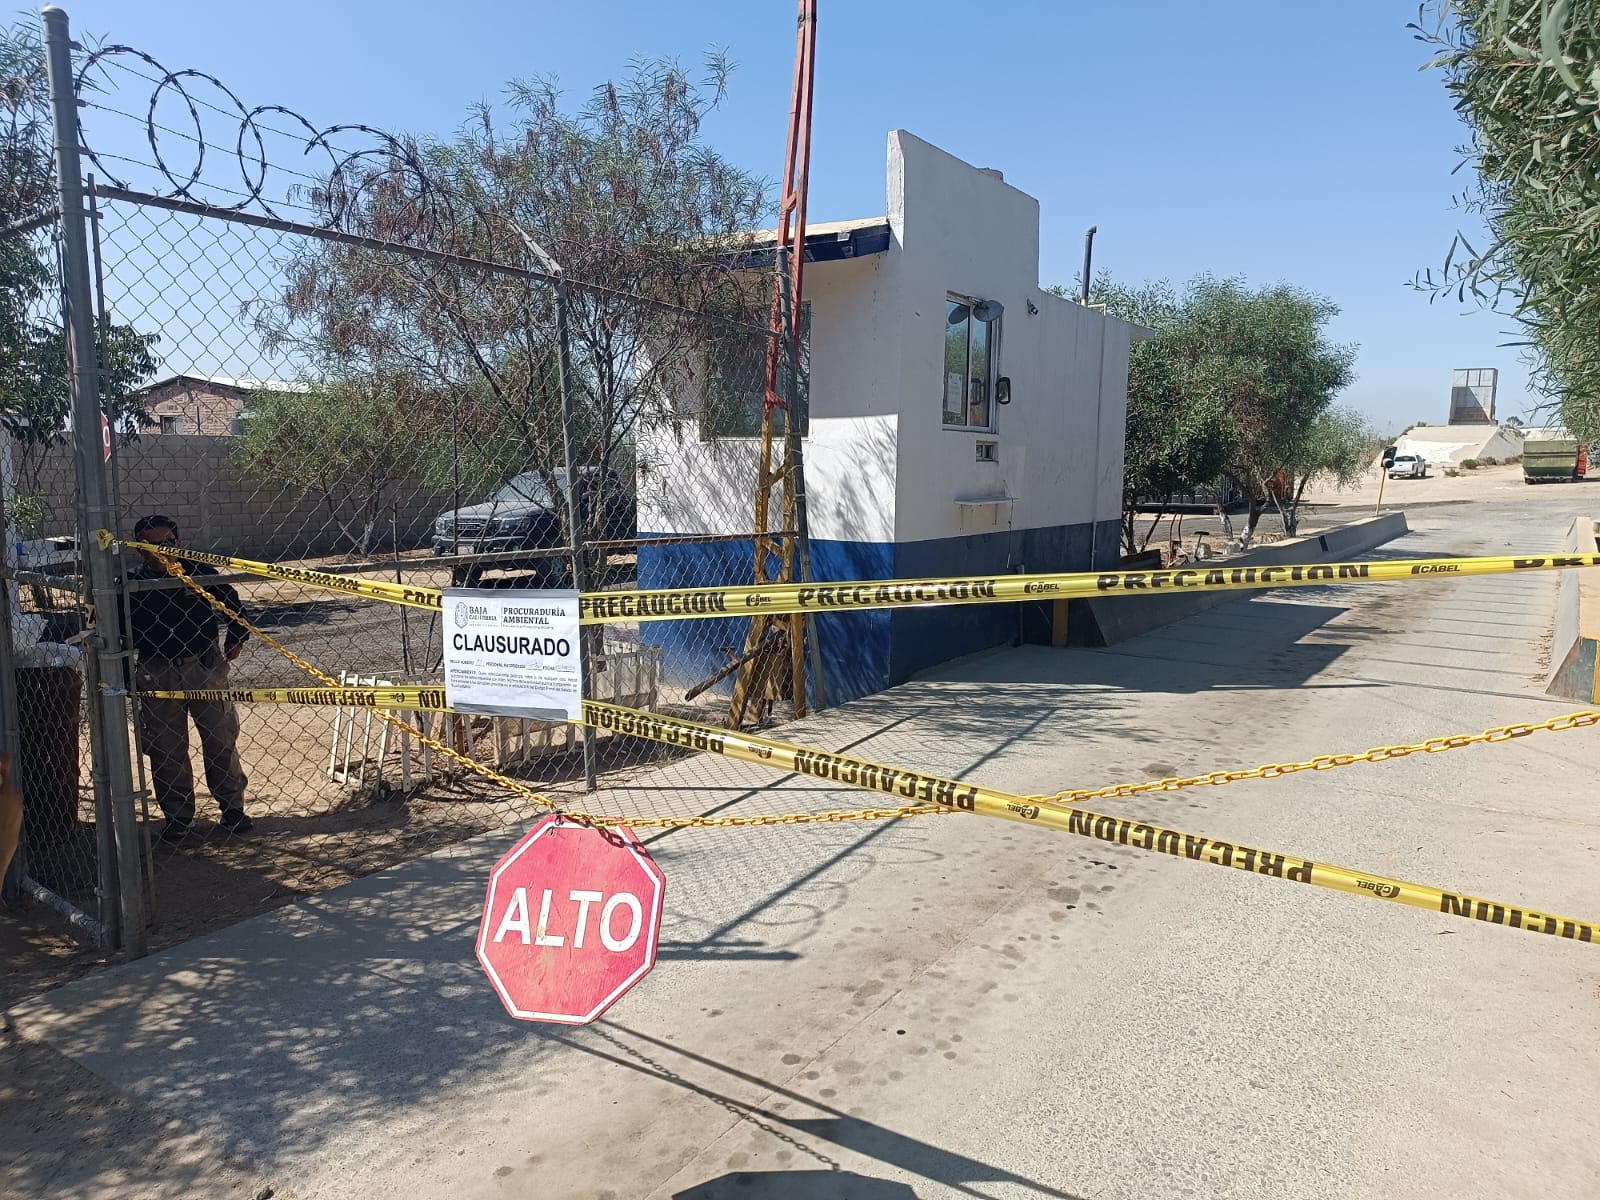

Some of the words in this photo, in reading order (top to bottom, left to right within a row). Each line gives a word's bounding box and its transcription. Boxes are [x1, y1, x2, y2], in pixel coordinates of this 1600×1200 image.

[580, 592, 727, 618] PRECAUCION
[798, 579, 996, 607] PRECAUCION
[1026, 582, 1060, 592] CABEL
[1415, 564, 1460, 574] CABEL
[469, 606, 488, 615] BAJA
[502, 616, 550, 625] AMBIENTAL
[503, 606, 566, 617] PROCURADURÍA
[453, 633, 570, 657] CLAUSURADO
[585, 705, 728, 754] PRECAUCION
[794, 750, 978, 811] PRECAUCION
[1006, 804, 1036, 817] CABEL
[1068, 809, 1313, 884] PRECAUCION
[1356, 880, 1395, 896] CABEL
[493, 887, 643, 953] ALTO
